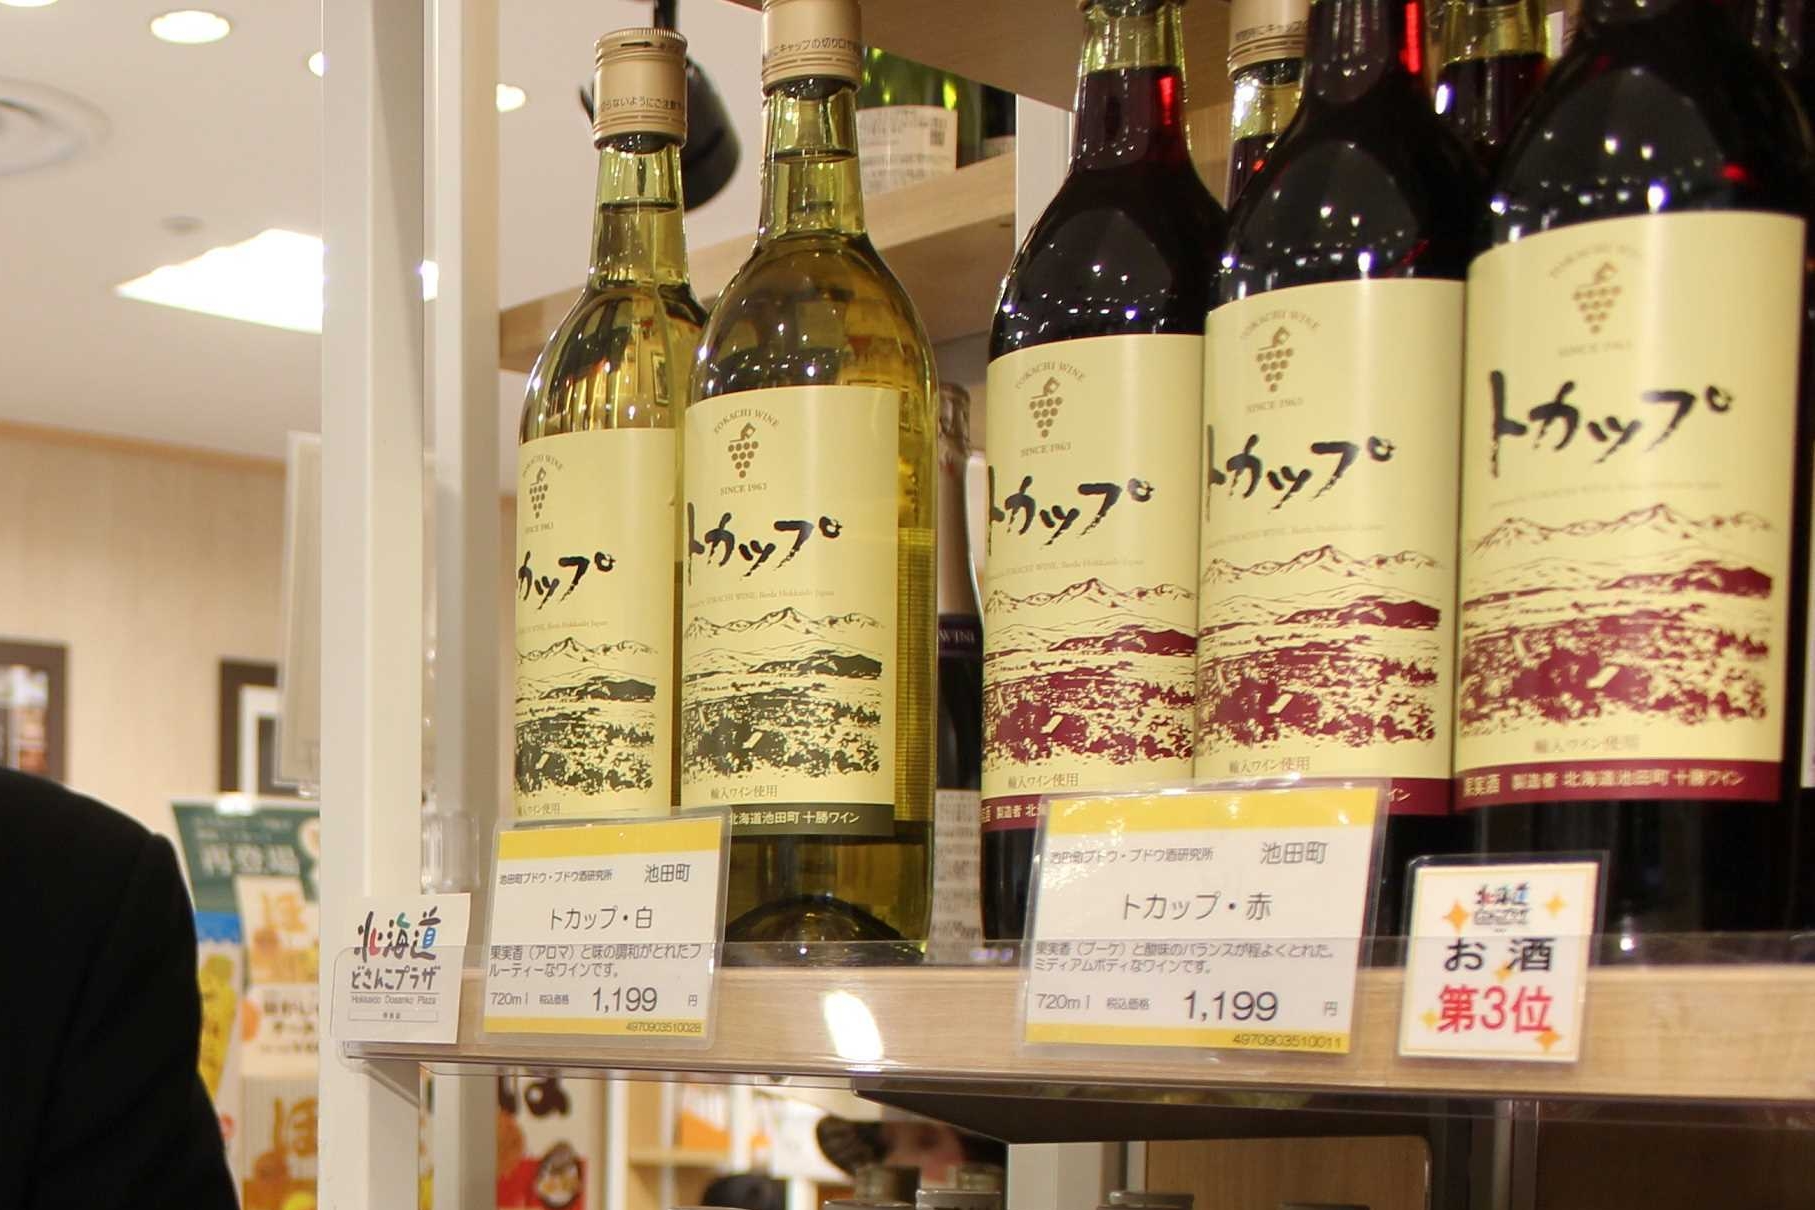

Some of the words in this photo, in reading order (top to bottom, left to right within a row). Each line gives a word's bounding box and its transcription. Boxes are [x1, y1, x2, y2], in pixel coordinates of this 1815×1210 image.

[1489, 368, 1736, 480] トカップ
[1205, 423, 1397, 524] トカップ
[987, 465, 1155, 557] トカップ
[687, 502, 843, 586] トカップ
[1260, 841, 1328, 865] 池田町
[644, 863, 690, 884] 池田町
[550, 905, 653, 931] トカップ・白
[1122, 890, 1273, 922] トカップ・赤
[353, 906, 442, 963] 北海道
[1444, 937, 1556, 972] お酒
[351, 965, 441, 990] どさんこプラザ
[592, 986, 659, 1013] 1,199
[687, 994, 698, 1007] 円
[1183, 990, 1279, 1023] 1,199
[1323, 1001, 1338, 1016] 円
[1437, 984, 1553, 1034] 第3位
